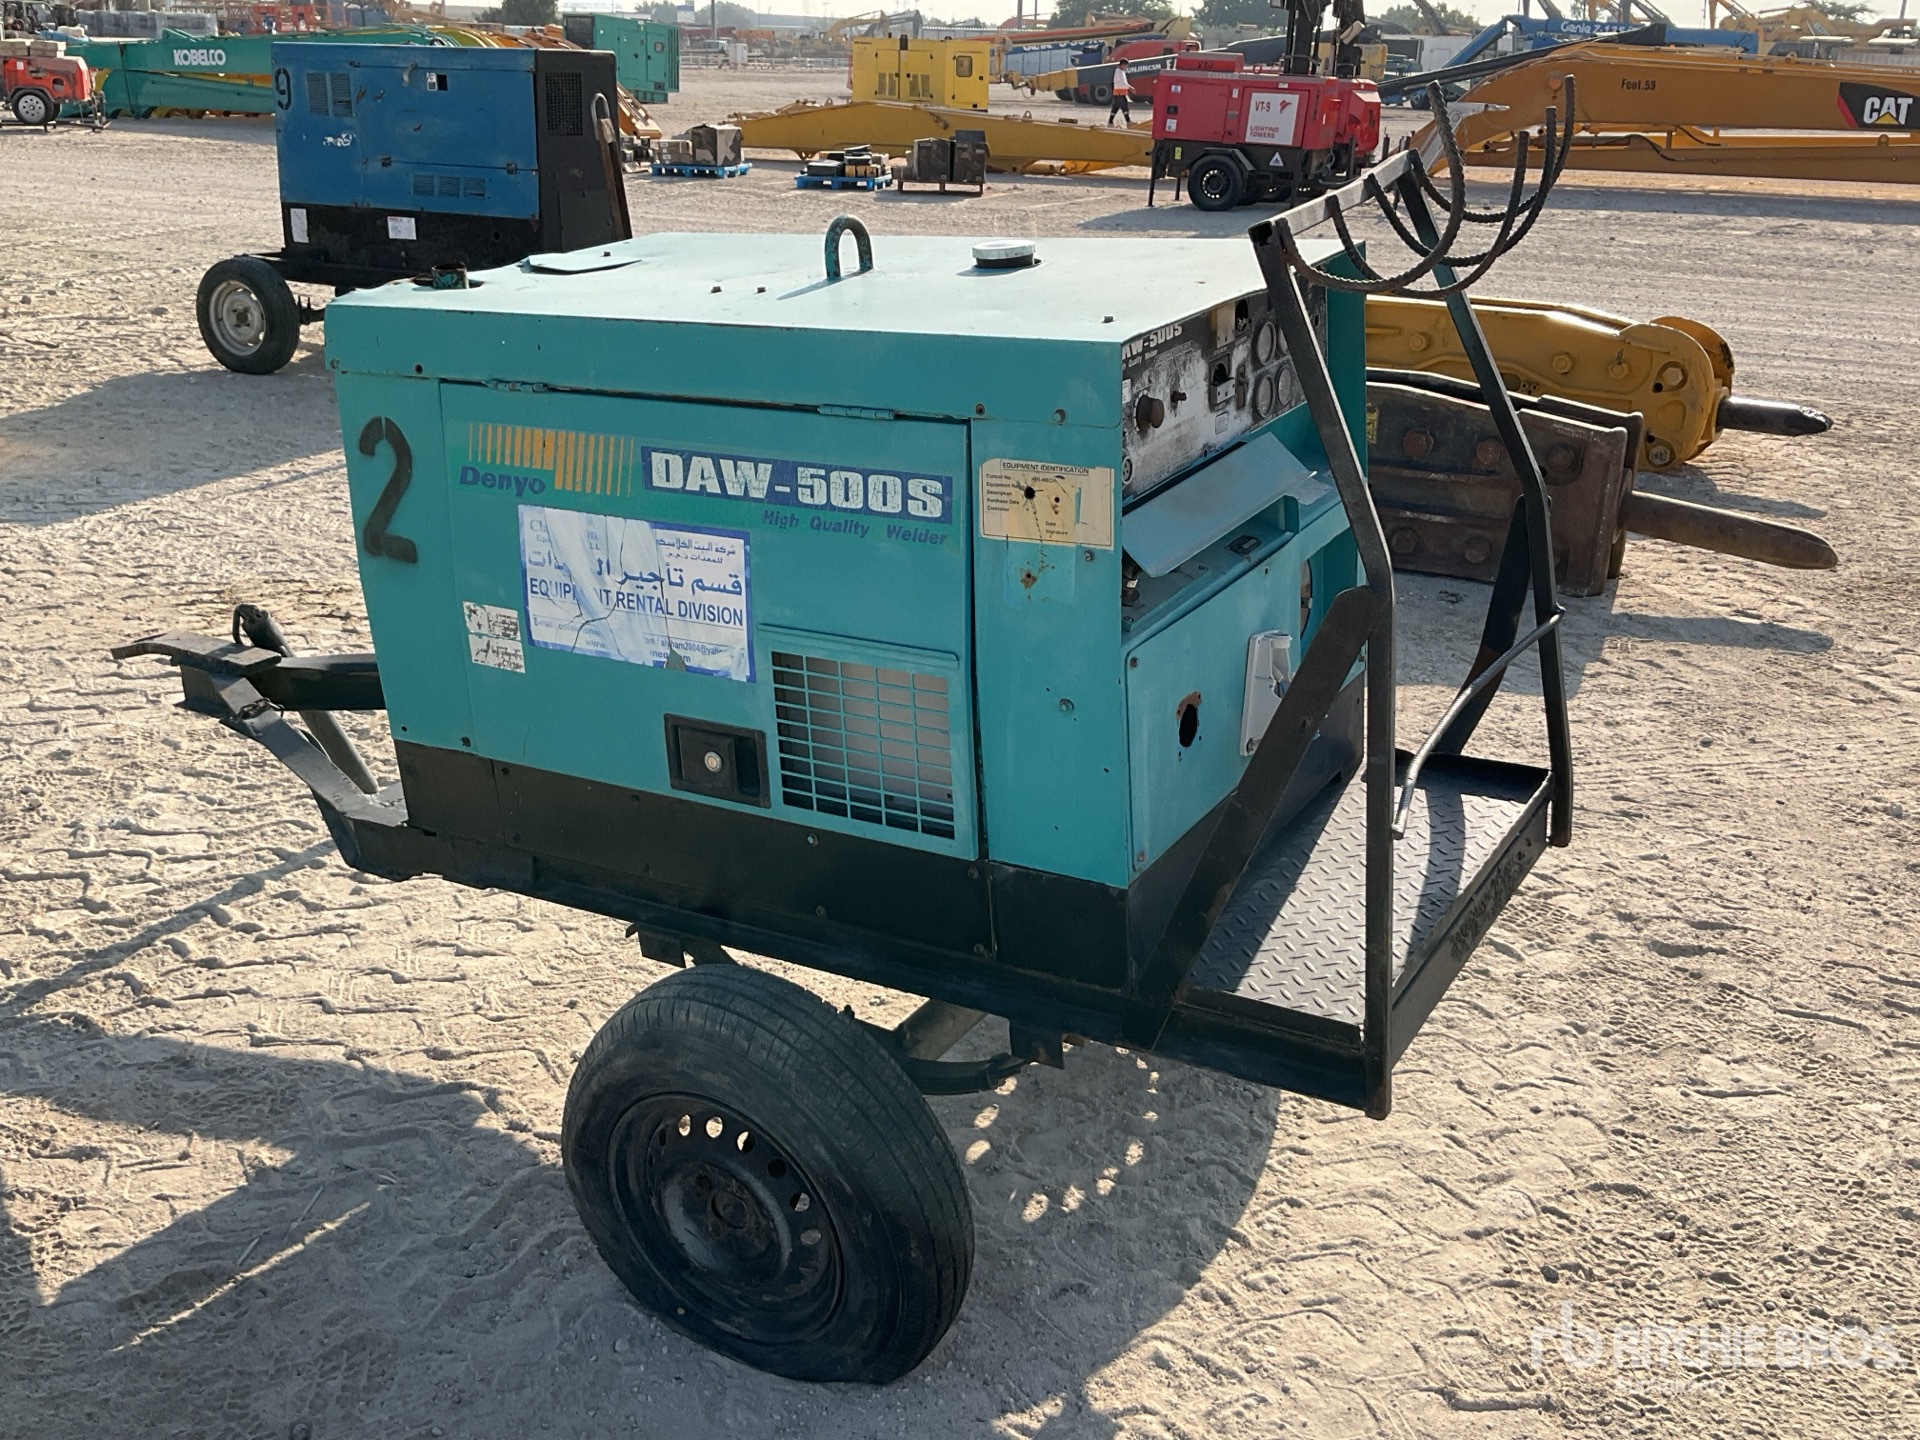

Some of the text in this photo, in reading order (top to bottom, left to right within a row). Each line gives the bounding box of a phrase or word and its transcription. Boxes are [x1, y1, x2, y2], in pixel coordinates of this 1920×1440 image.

[1561, 21, 1591, 34] Genie
[173, 49, 227, 66] KOBELCO
[1124, 63, 1162, 75] UNJINCSM
[1255, 101, 1271, 113] VT-9
[1863, 96, 1913, 125] CAT
[1250, 125, 1279, 133] LIGHTING
[1250, 131, 1275, 139] TOWERS
[1122, 323, 1183, 361] AW-500S
[1003, 462, 1090, 474] EQUIPMENT IDENTIFICATION
[459, 465, 547, 497] Denyo
[650, 451, 944, 519] DAW-500S
[358, 416, 418, 564] 2
[762, 510, 947, 546] High Quality Welder
[694, 541, 713, 554] البيت
[715, 543, 736, 556] شركة
[690, 553, 723, 564] للمعدات
[616, 562, 684, 590] تأجير
[691, 573, 743, 596] قسم
[530, 577, 744, 627] EQUIPNT RENTAL DIVISION
